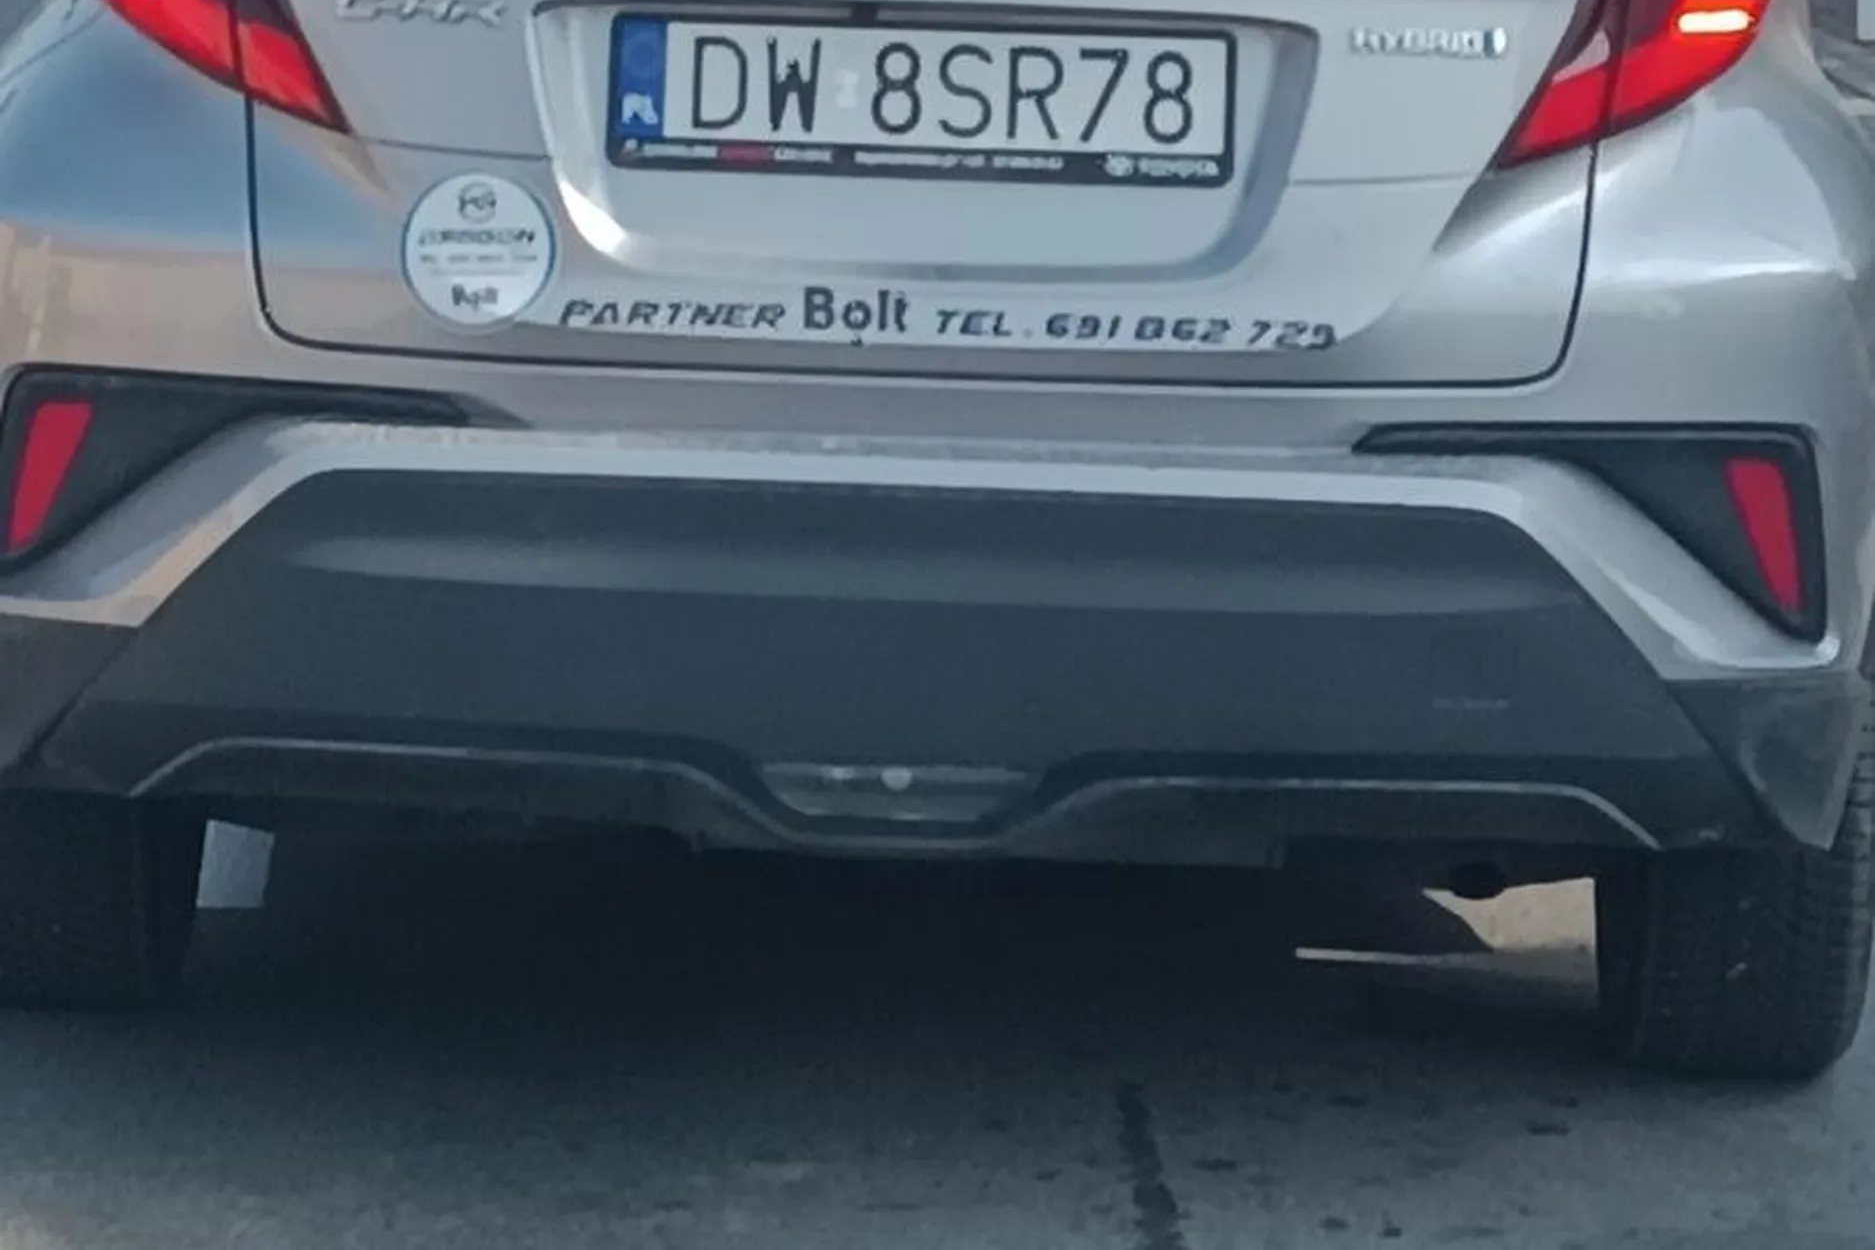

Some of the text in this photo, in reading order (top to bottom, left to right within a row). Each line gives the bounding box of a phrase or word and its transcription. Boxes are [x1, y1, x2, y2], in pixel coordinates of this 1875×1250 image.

[692, 34, 1193, 145] DW 8SR78
[559, 298, 786, 331] PARTNER
[803, 286, 910, 338] Bolt
[1046, 312, 1122, 340] 691
[1248, 319, 1337, 350] 729
